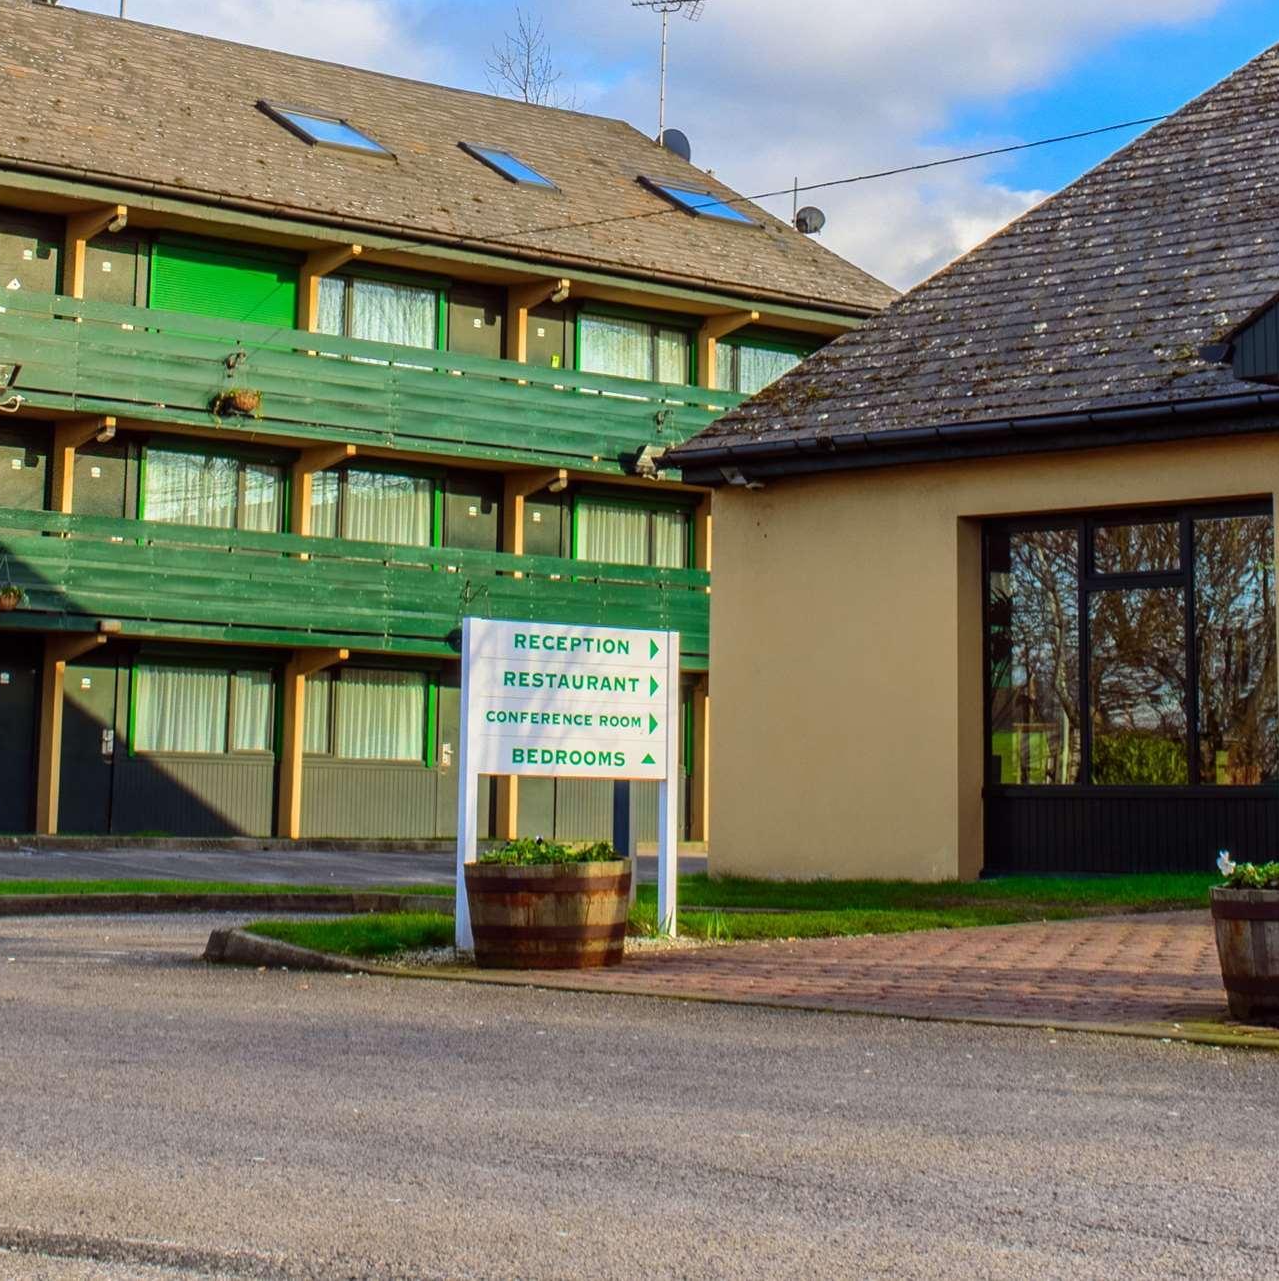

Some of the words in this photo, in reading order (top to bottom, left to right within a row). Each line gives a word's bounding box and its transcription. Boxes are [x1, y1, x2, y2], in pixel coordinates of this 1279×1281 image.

[514, 633, 629, 655] RECEPTION
[503, 671, 639, 692] RESTAURANT
[486, 710, 593, 727] CONFERENCE
[599, 715, 642, 728] ROOM
[512, 748, 625, 766] BEDROOMS
